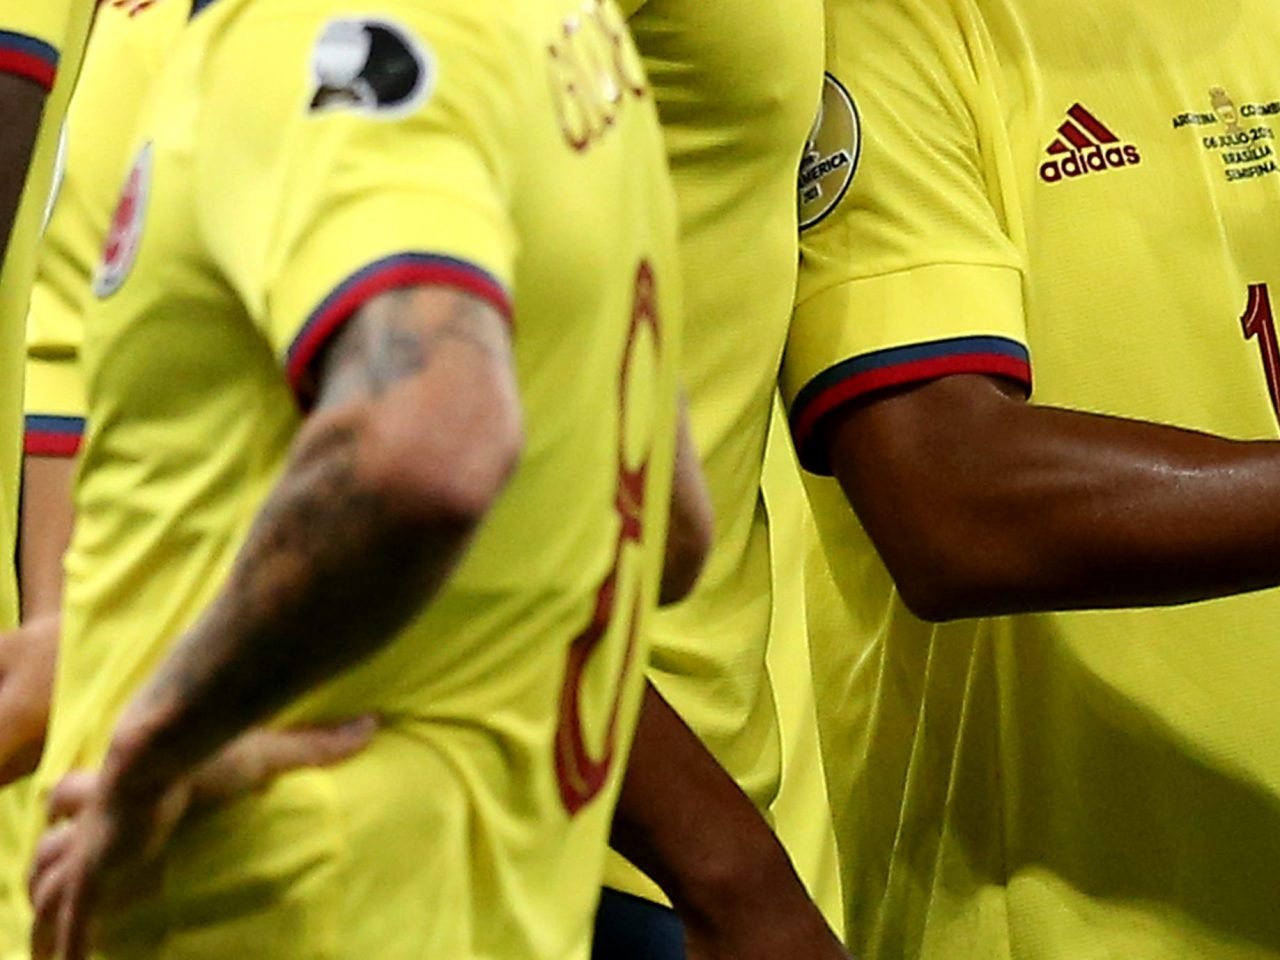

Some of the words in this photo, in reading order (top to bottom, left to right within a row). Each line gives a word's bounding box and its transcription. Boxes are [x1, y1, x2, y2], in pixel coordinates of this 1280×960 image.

[1040, 143, 1140, 182] adidas
[1225, 161, 1280, 181] SEMIFINA
[555, 258, 660, 817] 8
